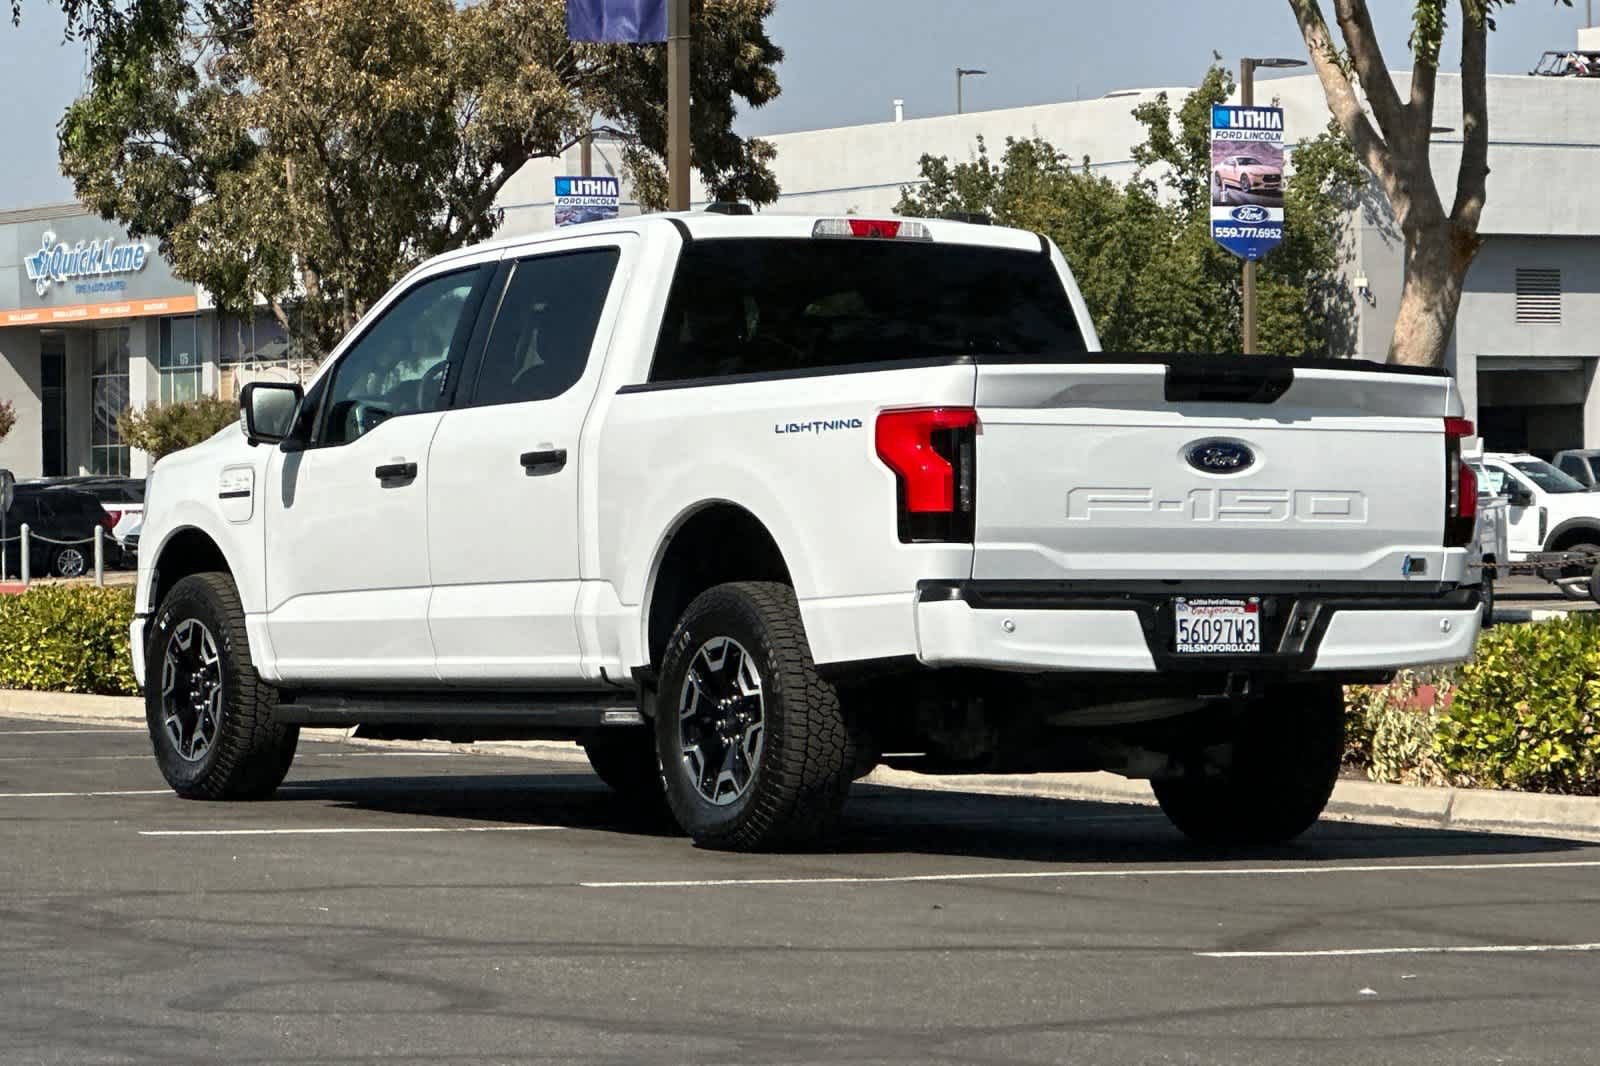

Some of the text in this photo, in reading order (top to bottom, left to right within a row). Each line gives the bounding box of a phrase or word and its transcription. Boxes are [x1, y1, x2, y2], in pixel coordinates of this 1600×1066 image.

[1229, 110, 1282, 129] LITHIA
[1215, 131, 1281, 140] FORD LINCOLN
[570, 180, 617, 195] LITHIA
[558, 197, 617, 205] FORD LINCOLN
[1237, 207, 1264, 220] Ford
[1215, 227, 1282, 239] 559.777.6952
[50, 240, 147, 281] Quick Lane
[774, 418, 863, 434] LIGHTNING
[1203, 448, 1241, 466] Ford
[1066, 486, 1368, 523] F-150
[1179, 618, 1256, 644] 56097W3
[1176, 643, 1260, 652] FRESNOFORD.COM
